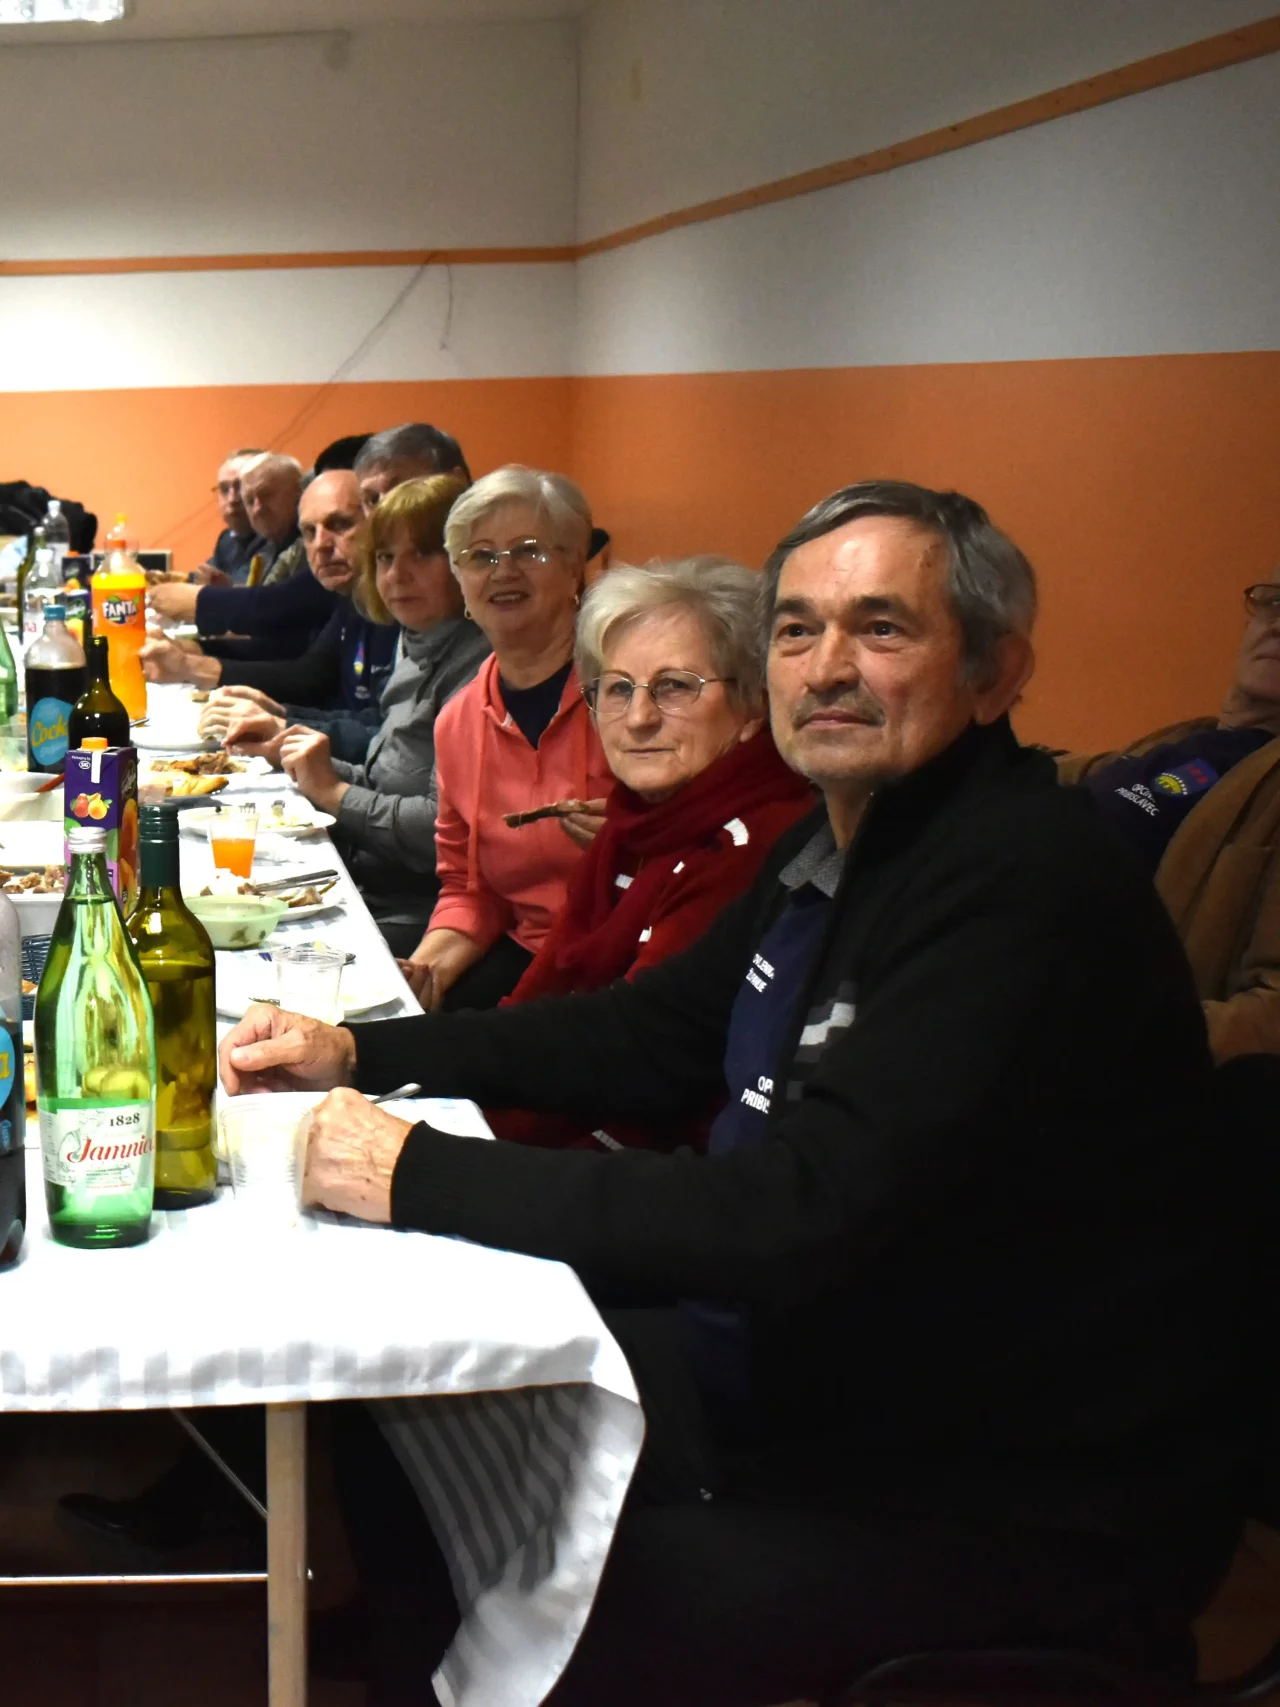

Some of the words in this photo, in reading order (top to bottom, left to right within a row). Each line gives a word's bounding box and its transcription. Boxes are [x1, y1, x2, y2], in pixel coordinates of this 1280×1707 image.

[102, 600, 137, 618] FANTA
[1115, 787, 1159, 816] PRIBISLAVEC
[758, 1076, 773, 1094] OP
[110, 1112, 140, 1126] 1828
